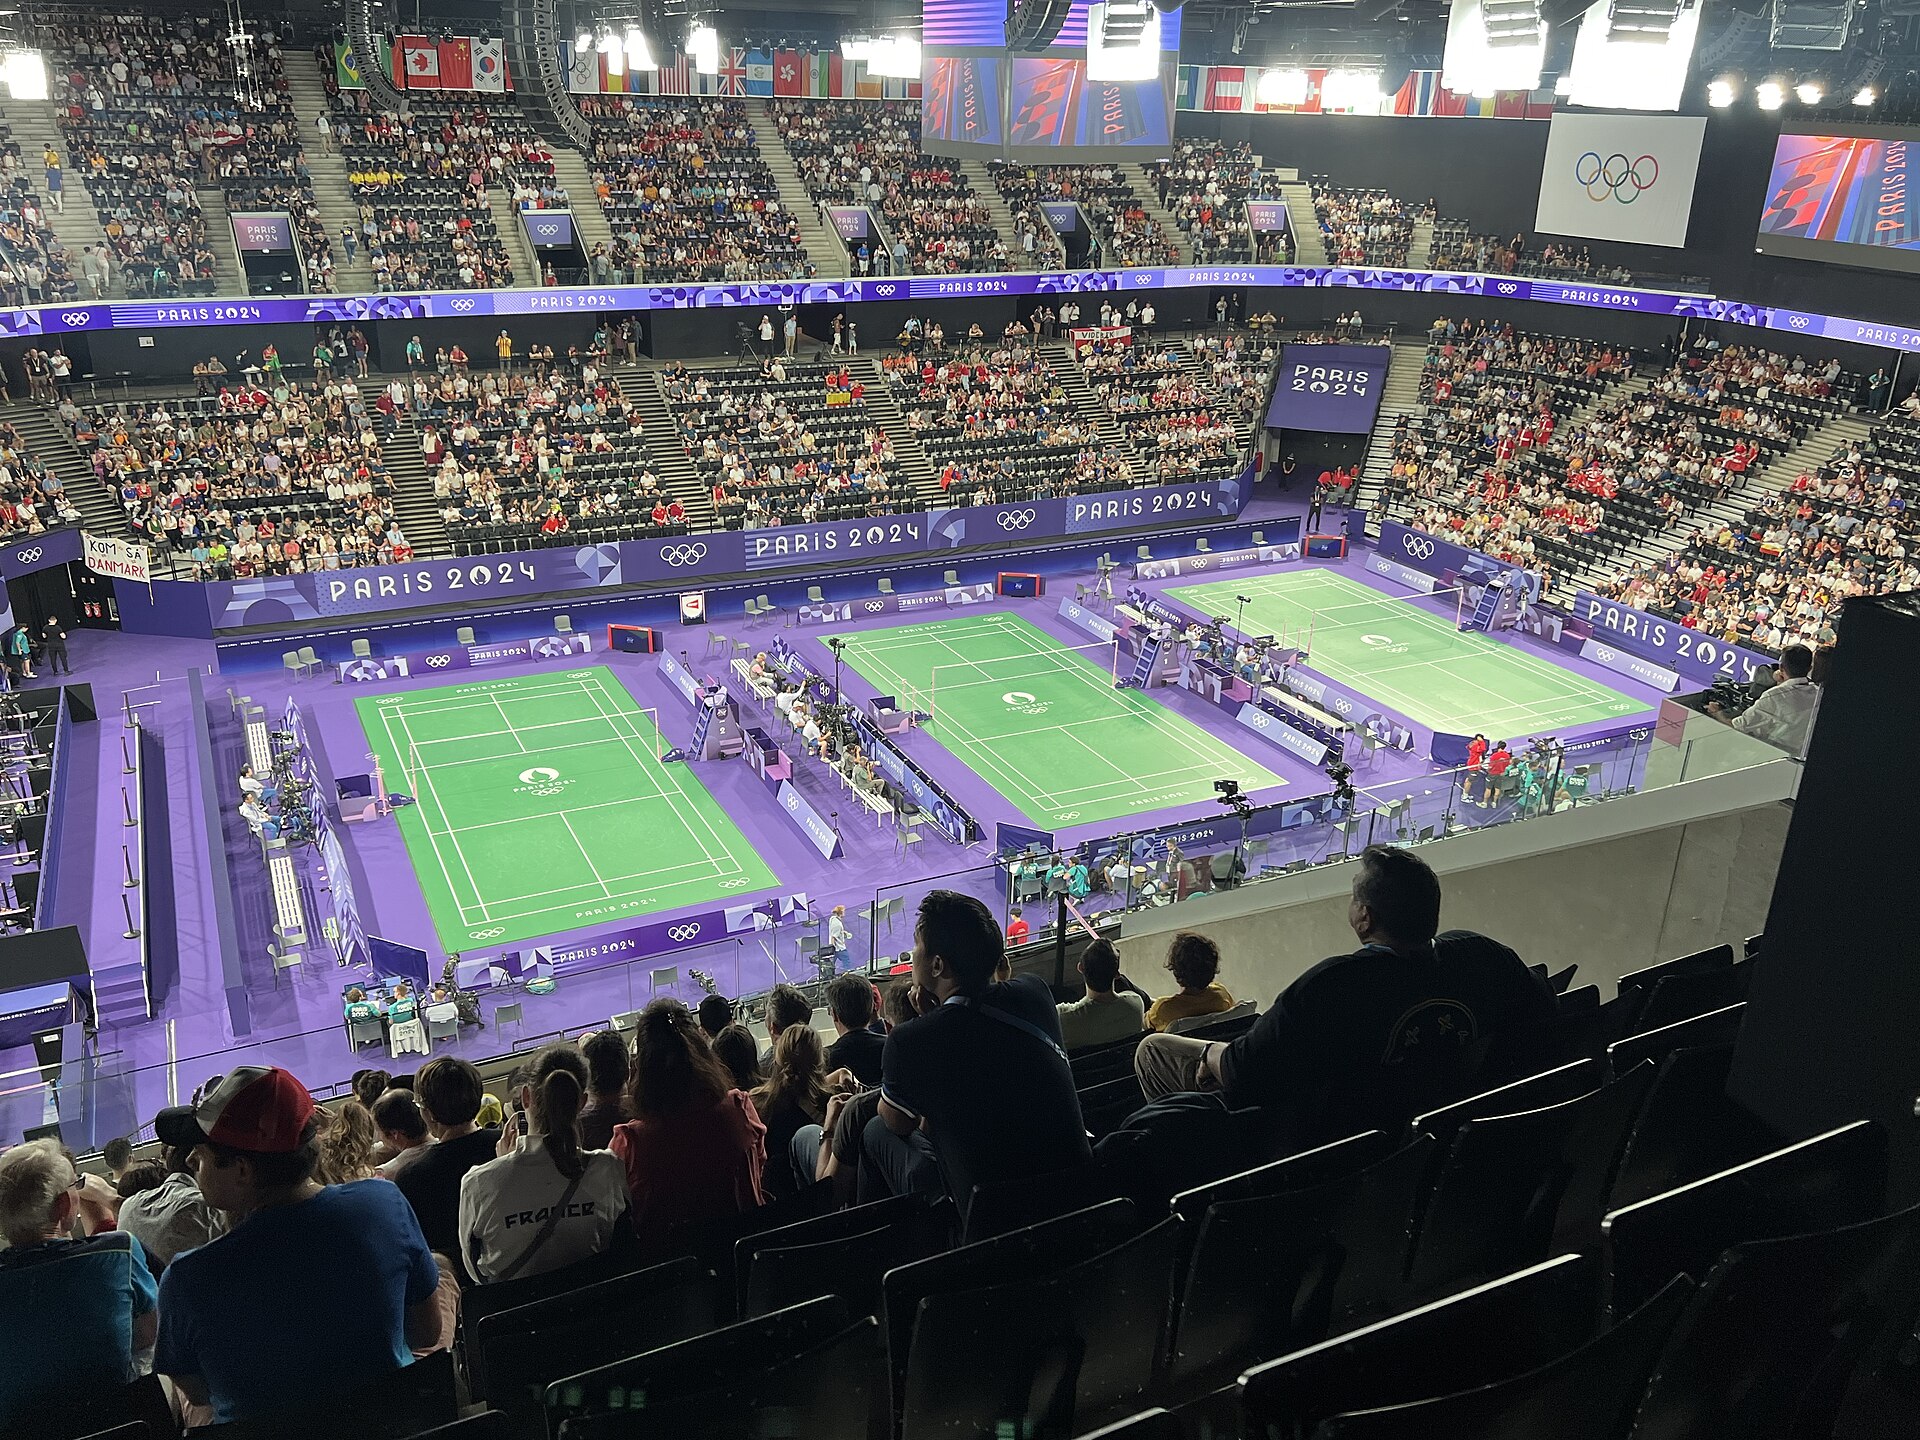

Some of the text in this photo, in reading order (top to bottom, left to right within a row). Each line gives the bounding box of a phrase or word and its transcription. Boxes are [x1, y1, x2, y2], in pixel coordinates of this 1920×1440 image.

[247, 225, 277, 234] PARIS
[249, 234, 278, 243] 2024
[1189, 272, 1256, 282] PARIS 2024
[939, 280, 1007, 294] PARIS 2024
[529, 294, 616, 309] PARIS 2024
[1561, 289, 1639, 307] PARIS 2024
[157, 306, 260, 321] PARIS 2024
[1856, 326, 1898, 343] PARIS
[1291, 378, 1366, 397] 2024
[1151, 490, 1212, 513] 2024
[849, 522, 919, 548] 2024
[89, 540, 142, 560] KOM SÅ
[88, 556, 146, 579] DANMARK
[446, 561, 536, 590] 2024
[474, 647, 527, 660] PARIS 2024
[1676, 633, 1757, 682] 2024
[1160, 828, 1214, 847] PRIS 2024
[559, 939, 635, 963] PARIS 2024
